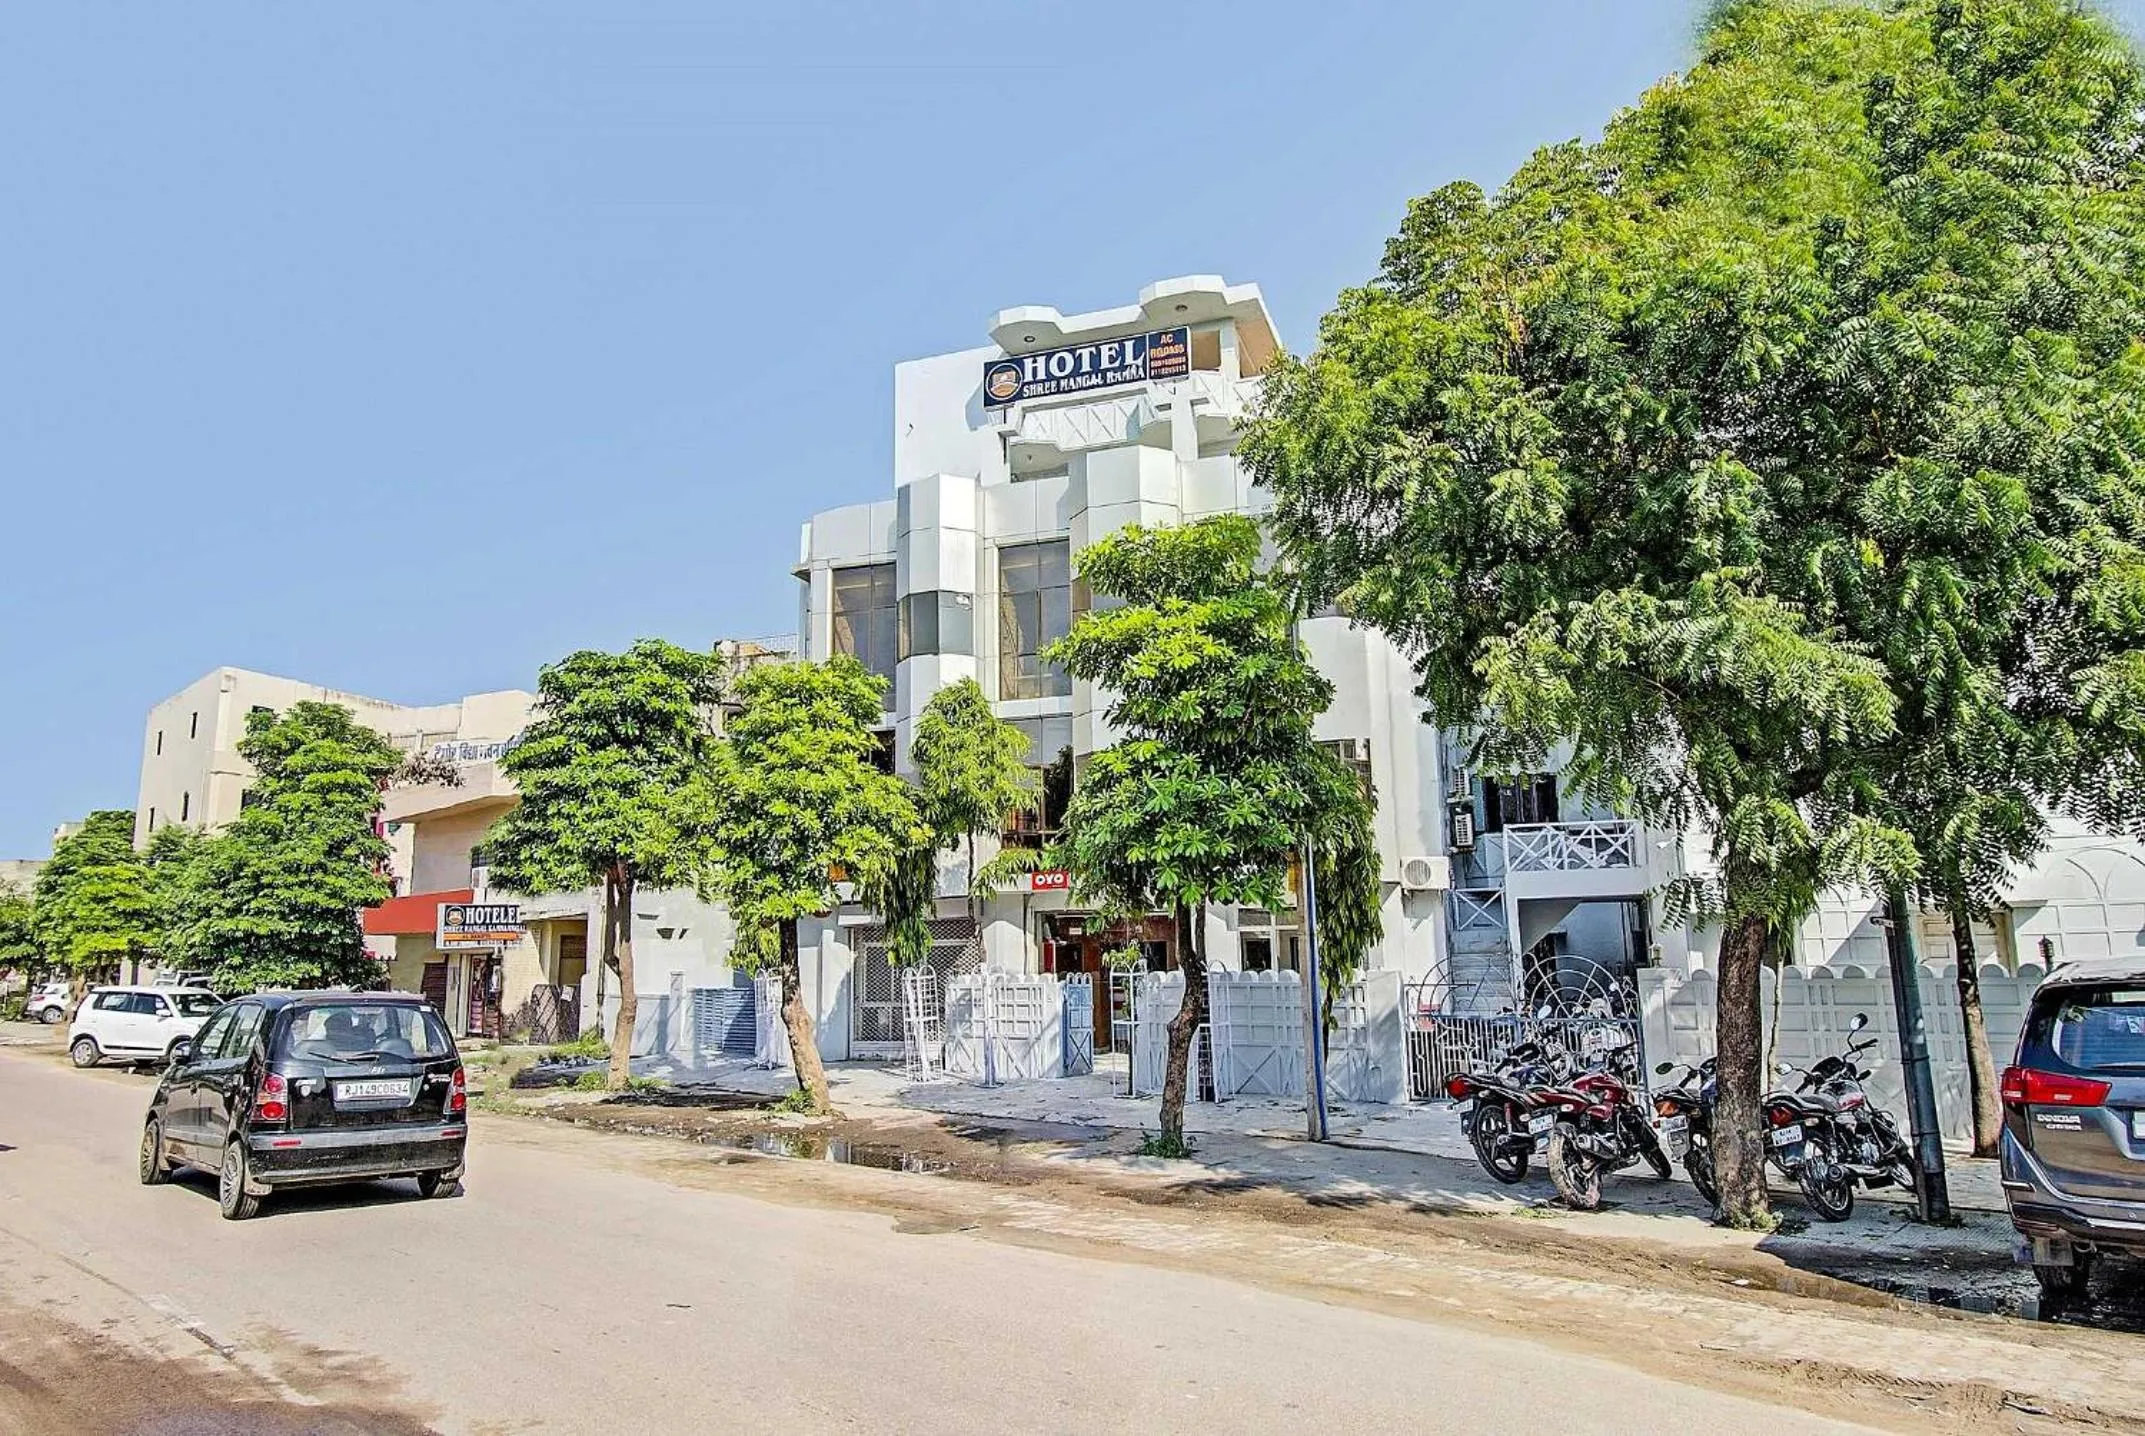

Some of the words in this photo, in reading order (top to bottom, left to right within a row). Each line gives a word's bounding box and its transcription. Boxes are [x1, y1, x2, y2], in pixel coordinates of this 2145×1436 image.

[1023, 339, 1146, 382] HOTEL
[1023, 379, 1058, 397] SHREE
[1060, 372, 1104, 392] MANGAL
[1035, 873, 1065, 886] OYO
